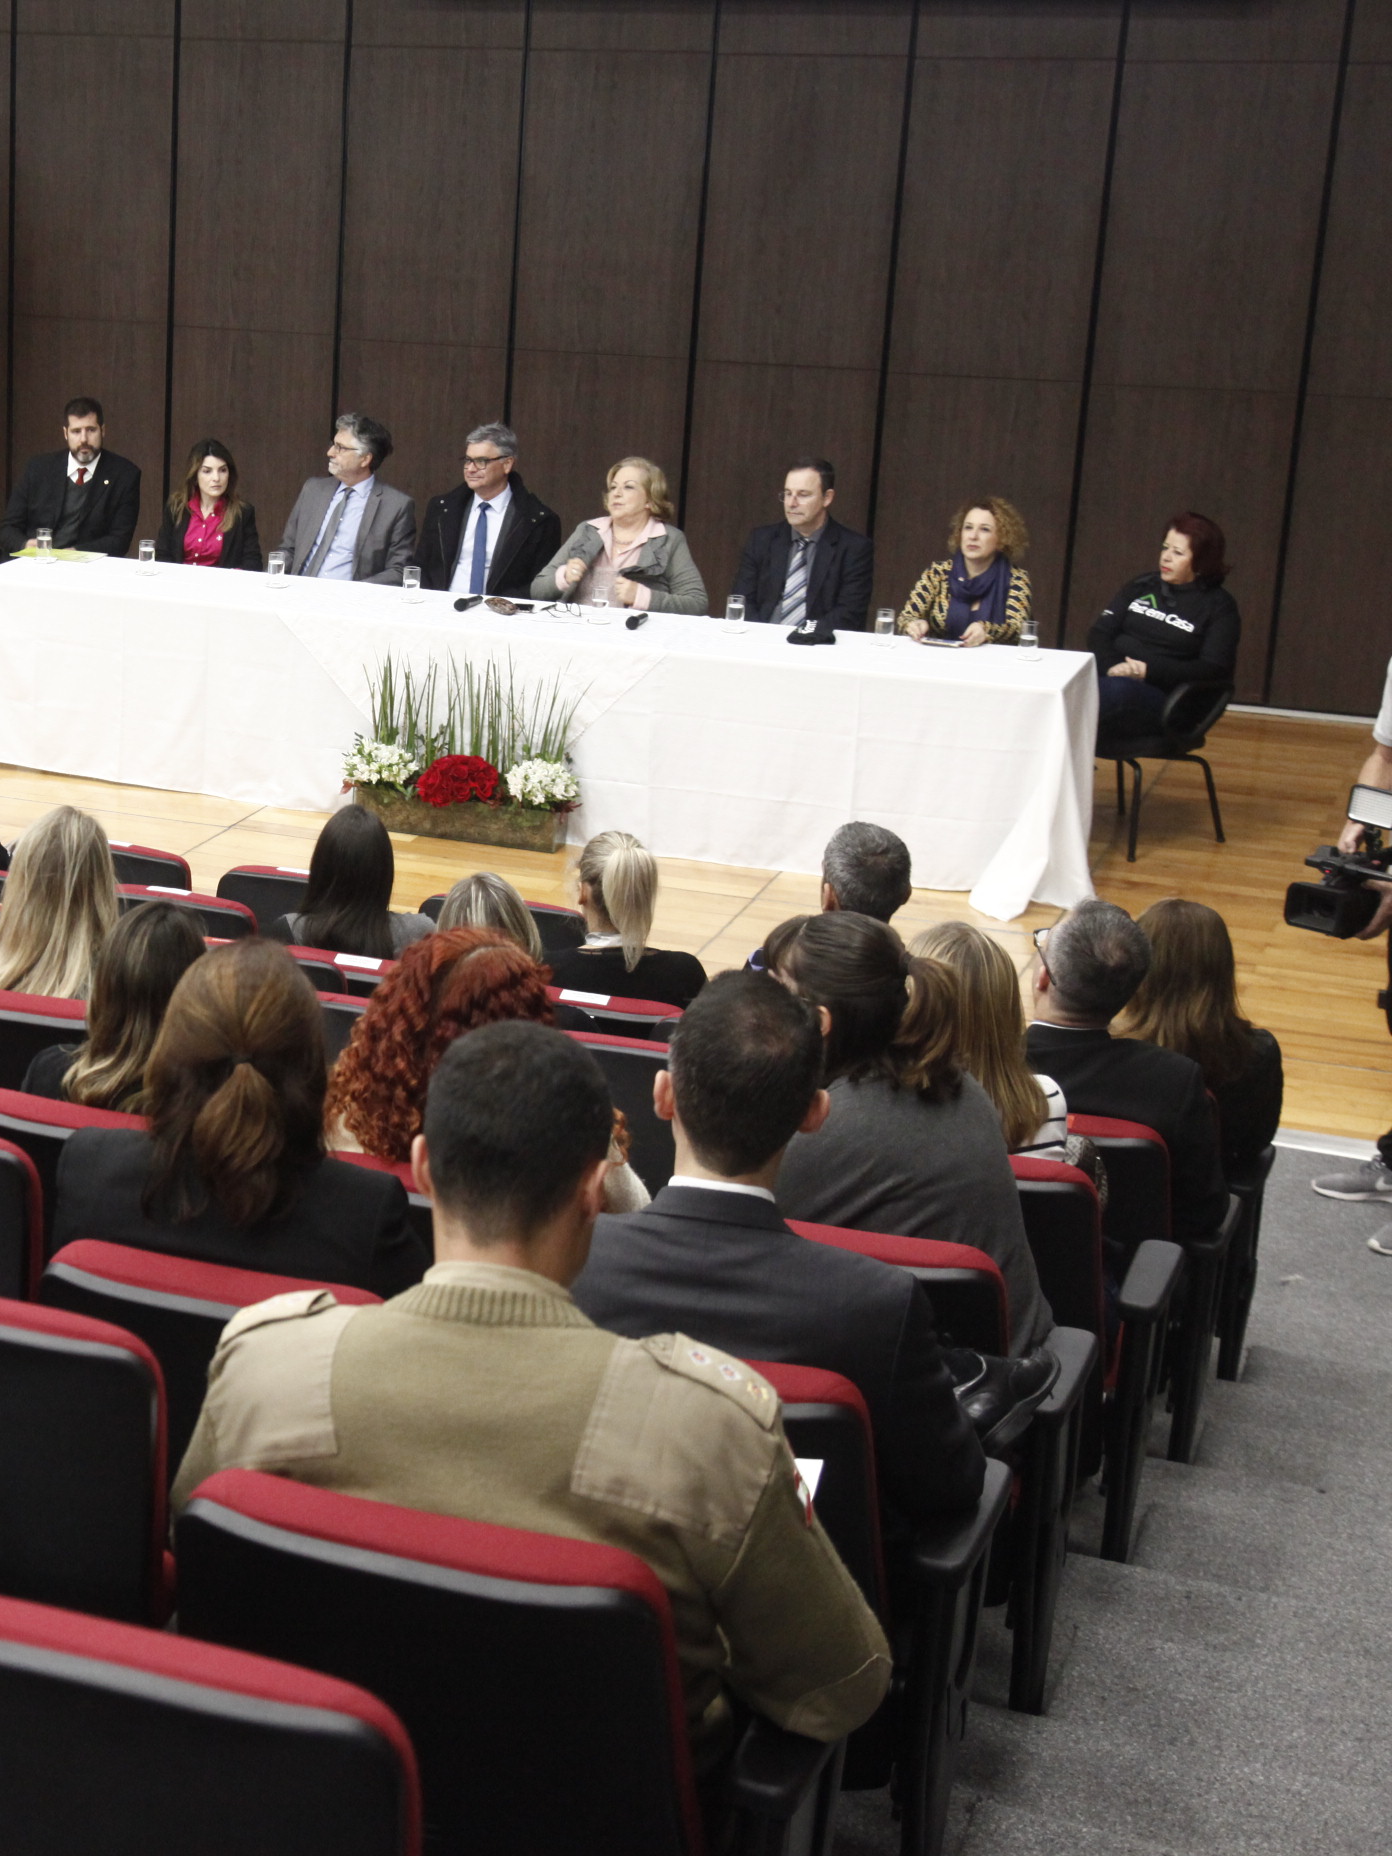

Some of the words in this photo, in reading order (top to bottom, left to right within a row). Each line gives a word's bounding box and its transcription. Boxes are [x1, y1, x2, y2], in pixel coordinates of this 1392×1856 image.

[1128, 601, 1148, 615] Paz
[1145, 608, 1167, 621] em
[1165, 614, 1195, 633] Casa
